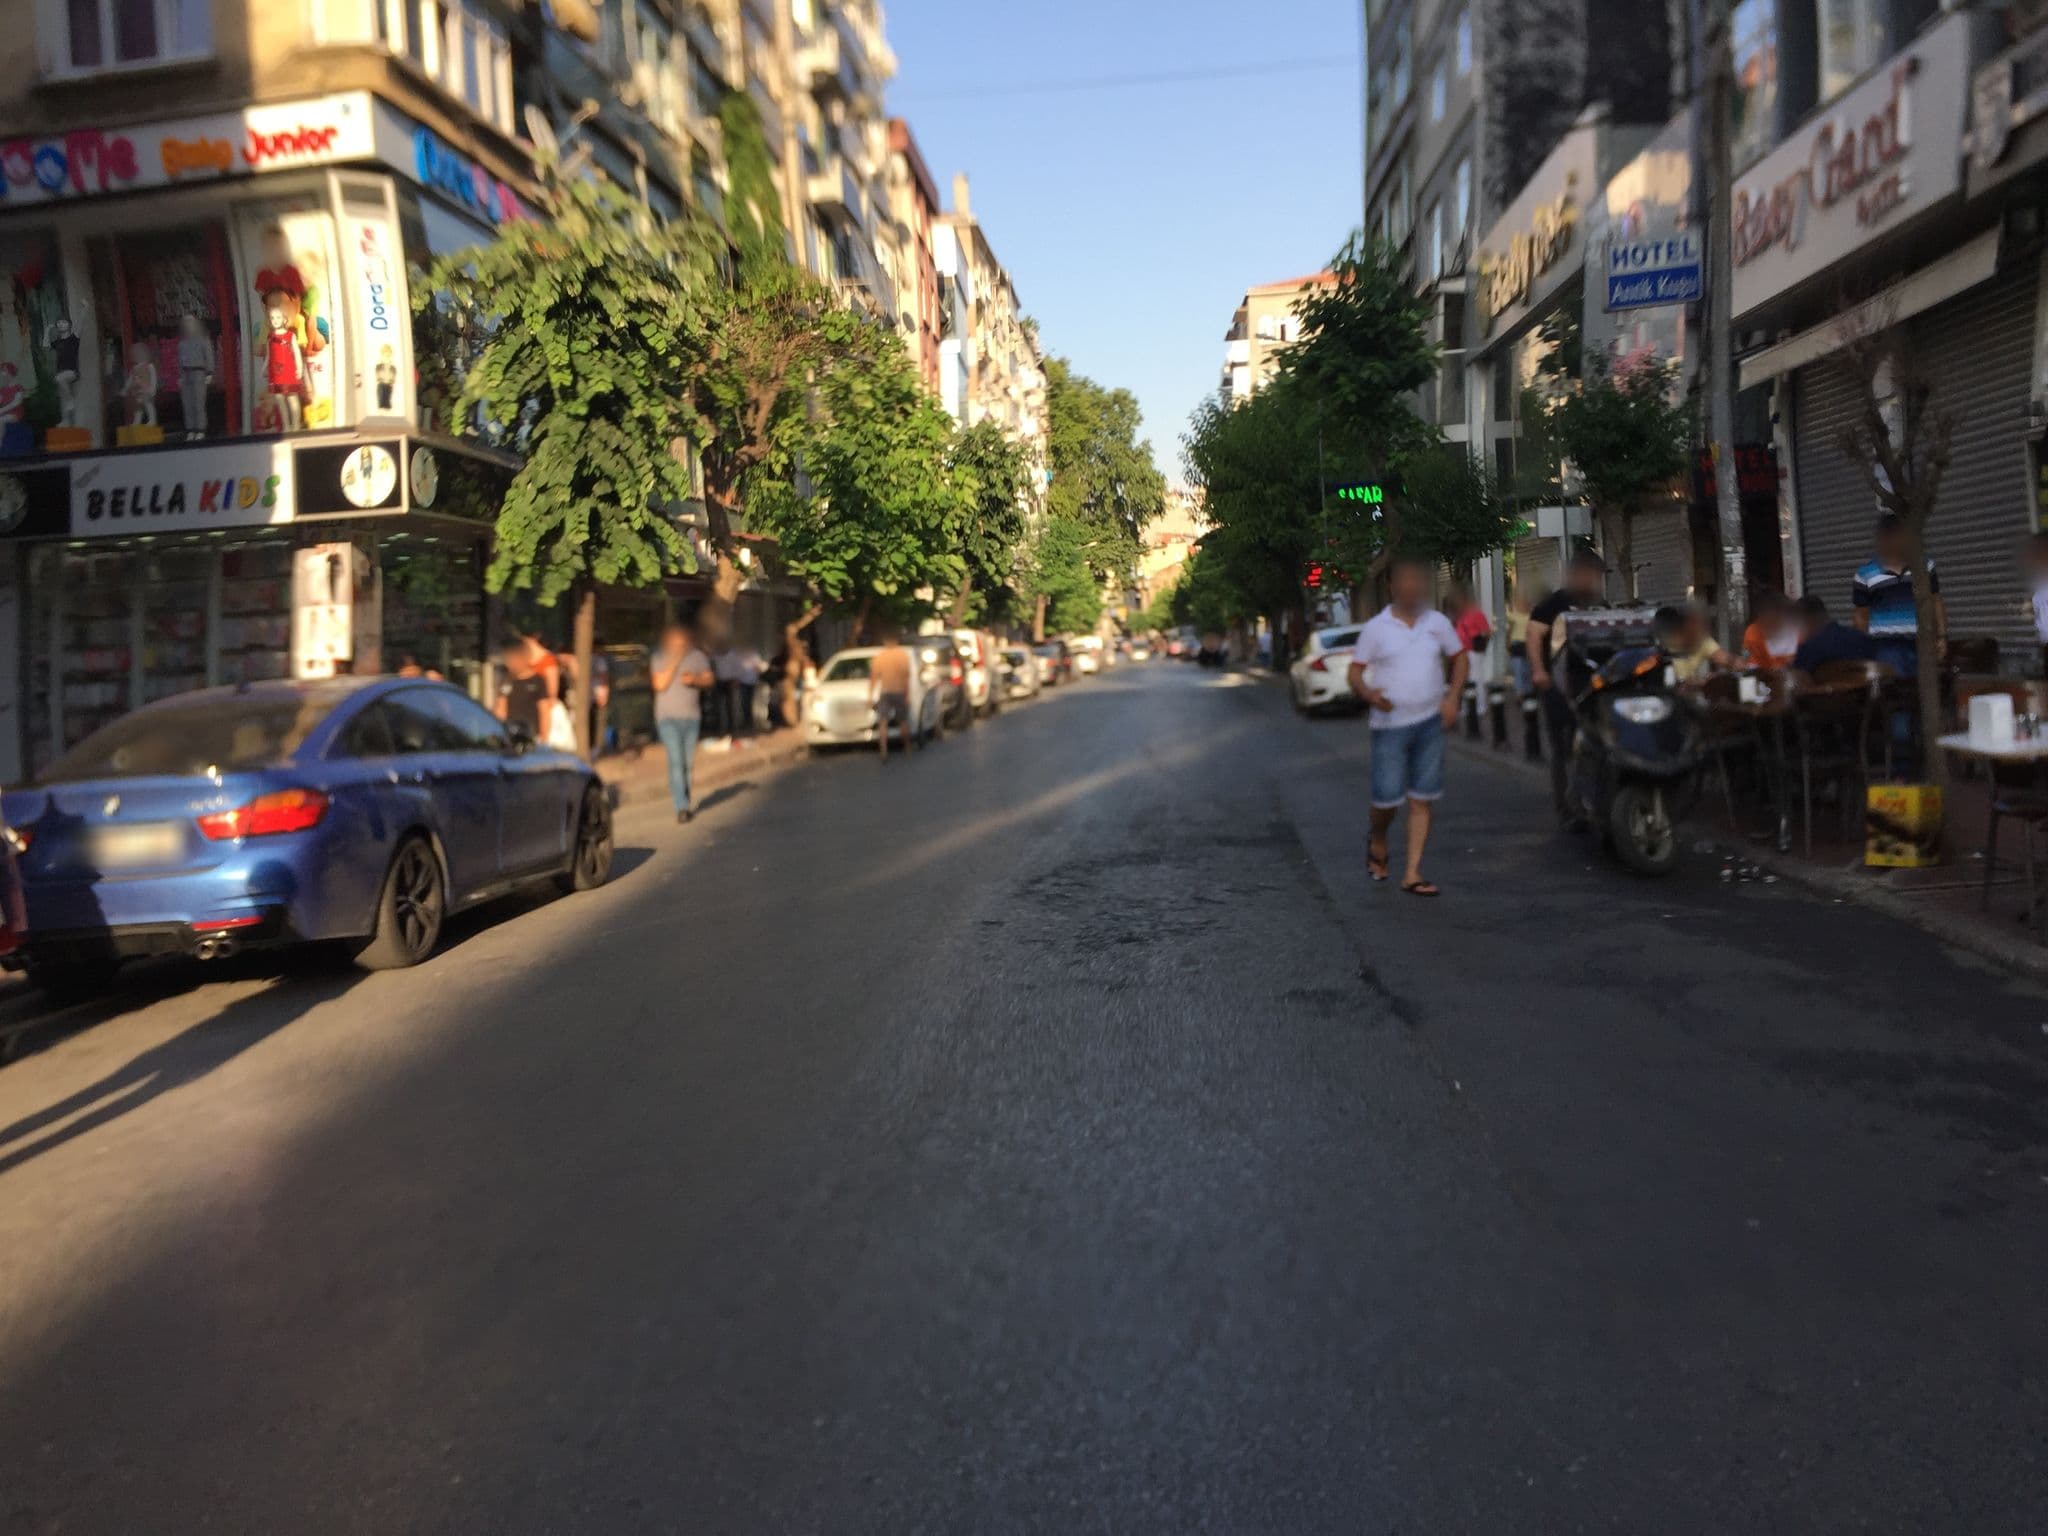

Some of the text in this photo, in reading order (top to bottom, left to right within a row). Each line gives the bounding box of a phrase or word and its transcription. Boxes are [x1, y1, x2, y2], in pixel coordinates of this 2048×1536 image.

[242, 126, 337, 166] Junior
[1611, 236, 1698, 269] HOTEL
[370, 282, 389, 331] Dora
[86, 474, 281, 521] BELLA KIDS
